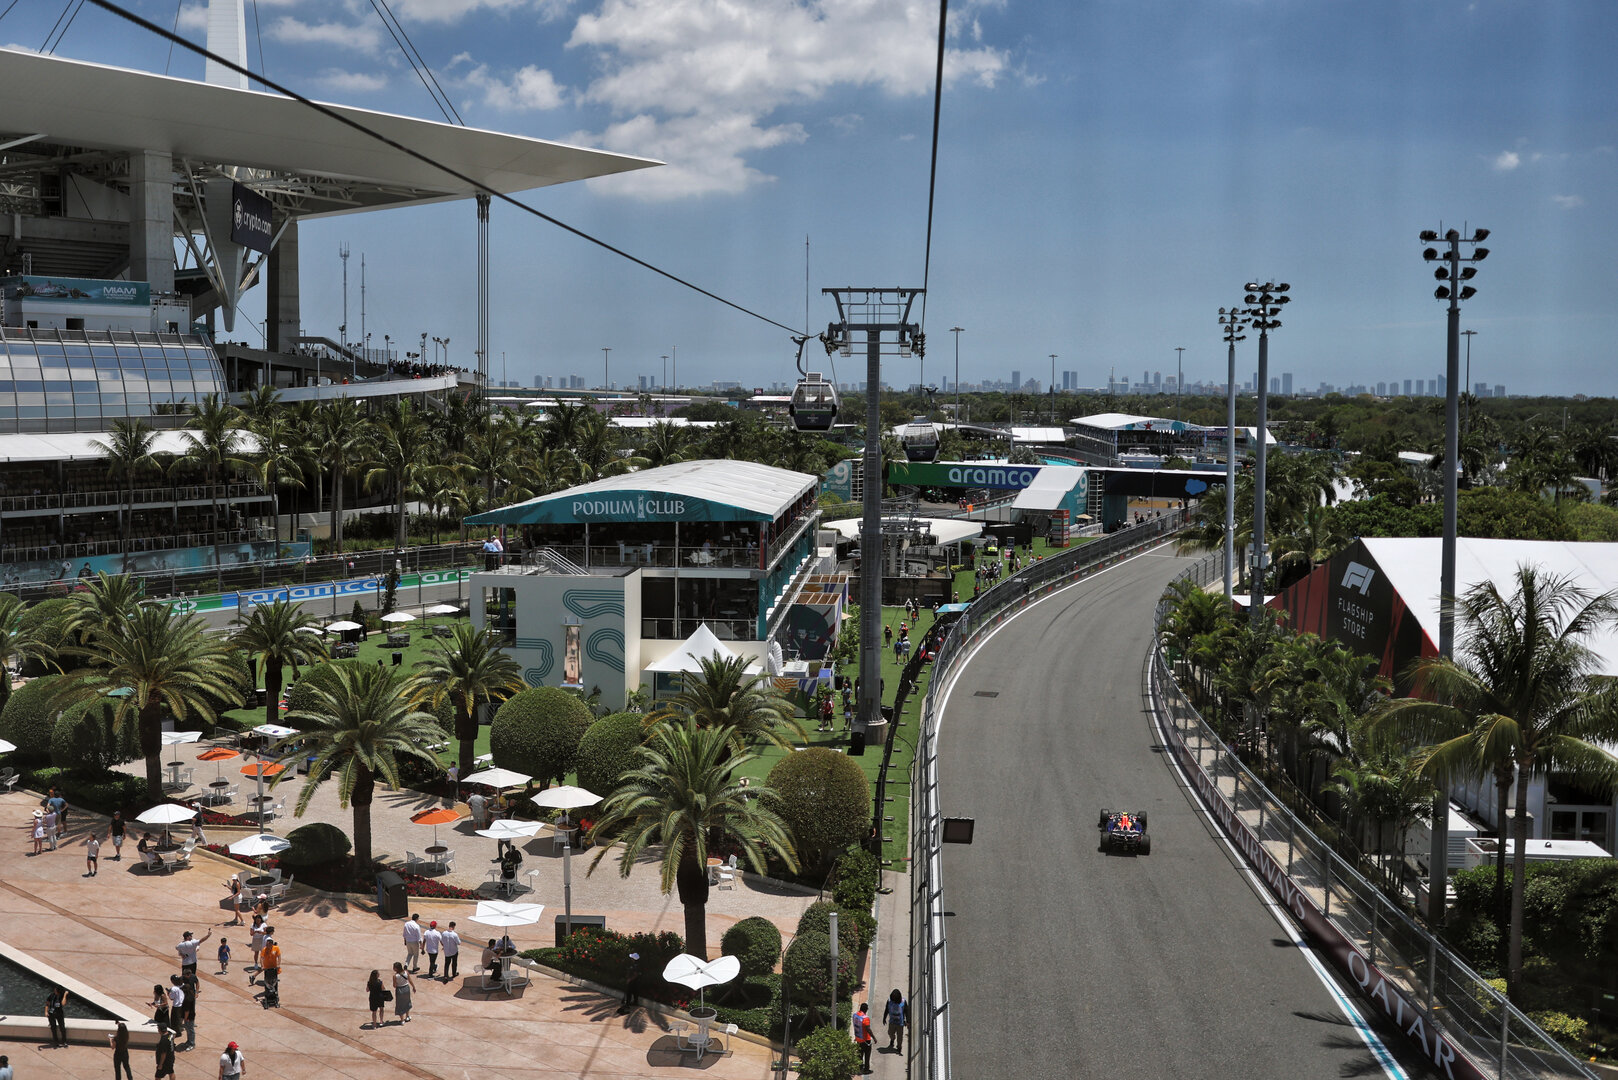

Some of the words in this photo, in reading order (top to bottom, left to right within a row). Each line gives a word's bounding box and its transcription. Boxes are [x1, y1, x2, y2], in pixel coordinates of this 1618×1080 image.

[243, 212, 272, 236] crypto.com
[103, 286, 137, 295] MIAMI
[833, 462, 849, 485] 9
[948, 467, 1033, 486] aramco
[1079, 472, 1088, 498] 9
[572, 500, 636, 516] PODIUM
[645, 500, 686, 515] CLUB
[248, 580, 382, 602] aramco
[1337, 597, 1375, 624] FLAGSHIP
[1343, 617, 1366, 640] STORE
[1197, 771, 1233, 833] QATAR
[1235, 823, 1306, 921] AIRWAYS
[1347, 950, 1456, 1080] QATAR
